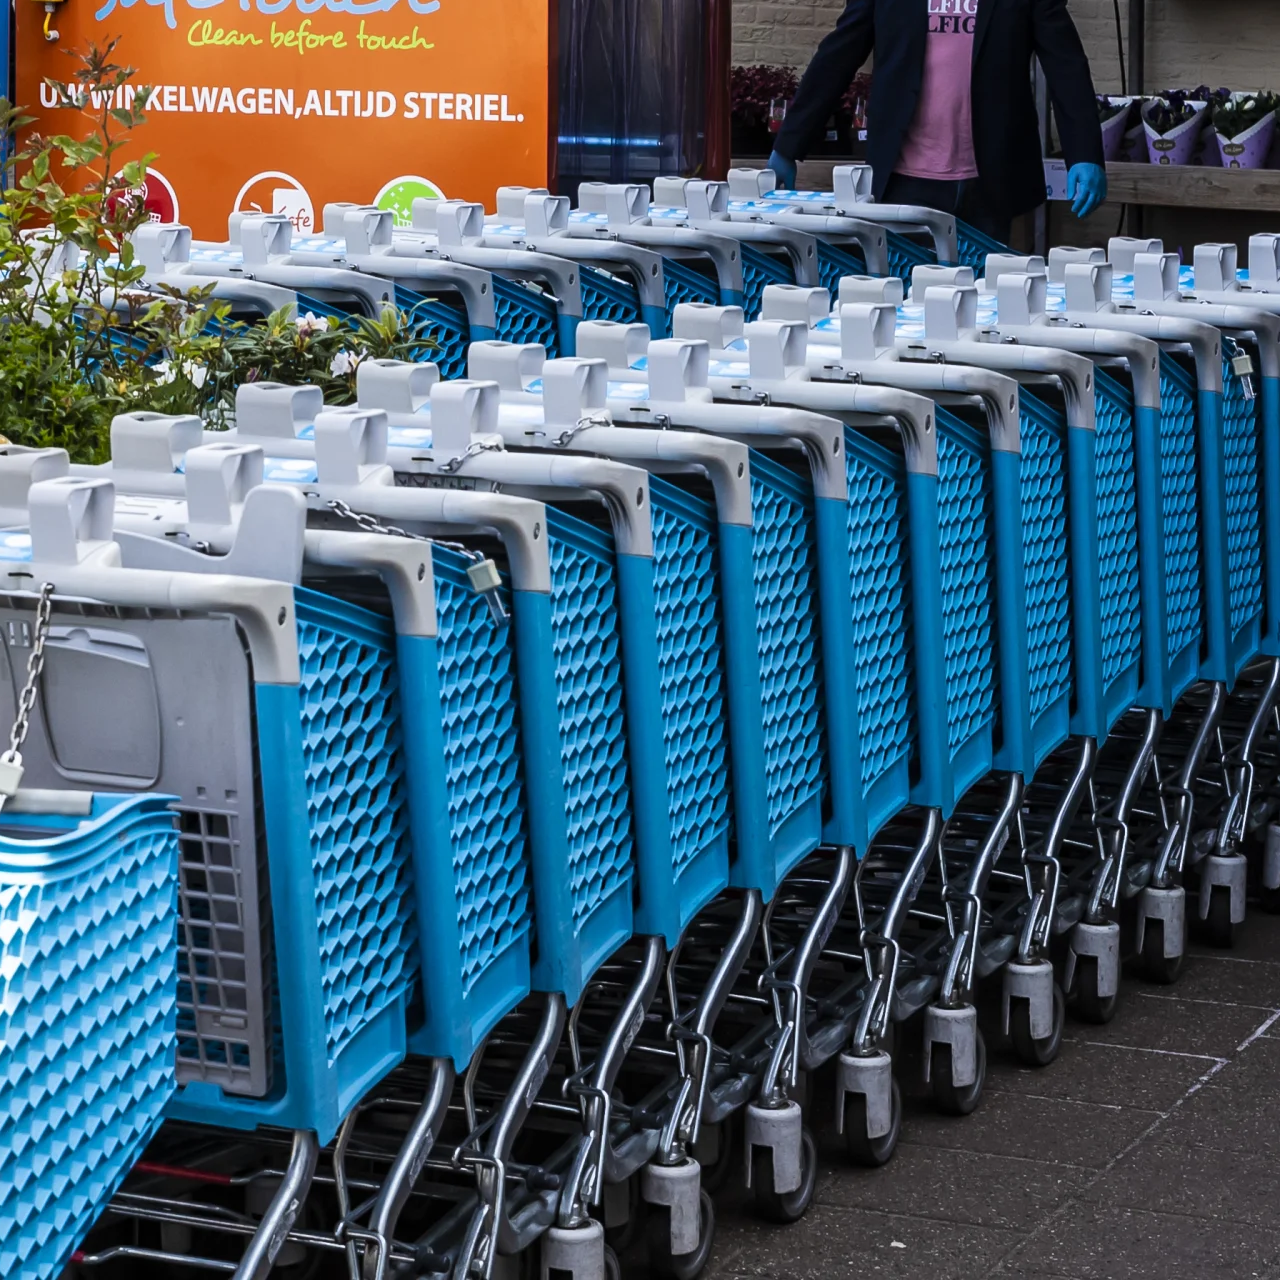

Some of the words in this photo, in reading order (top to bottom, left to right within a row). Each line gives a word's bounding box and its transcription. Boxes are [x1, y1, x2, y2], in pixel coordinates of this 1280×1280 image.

[187, 20, 263, 48] Clean
[270, 22, 347, 55] before
[357, 20, 434, 50] touch
[404, 90, 525, 122] STERIEL.
